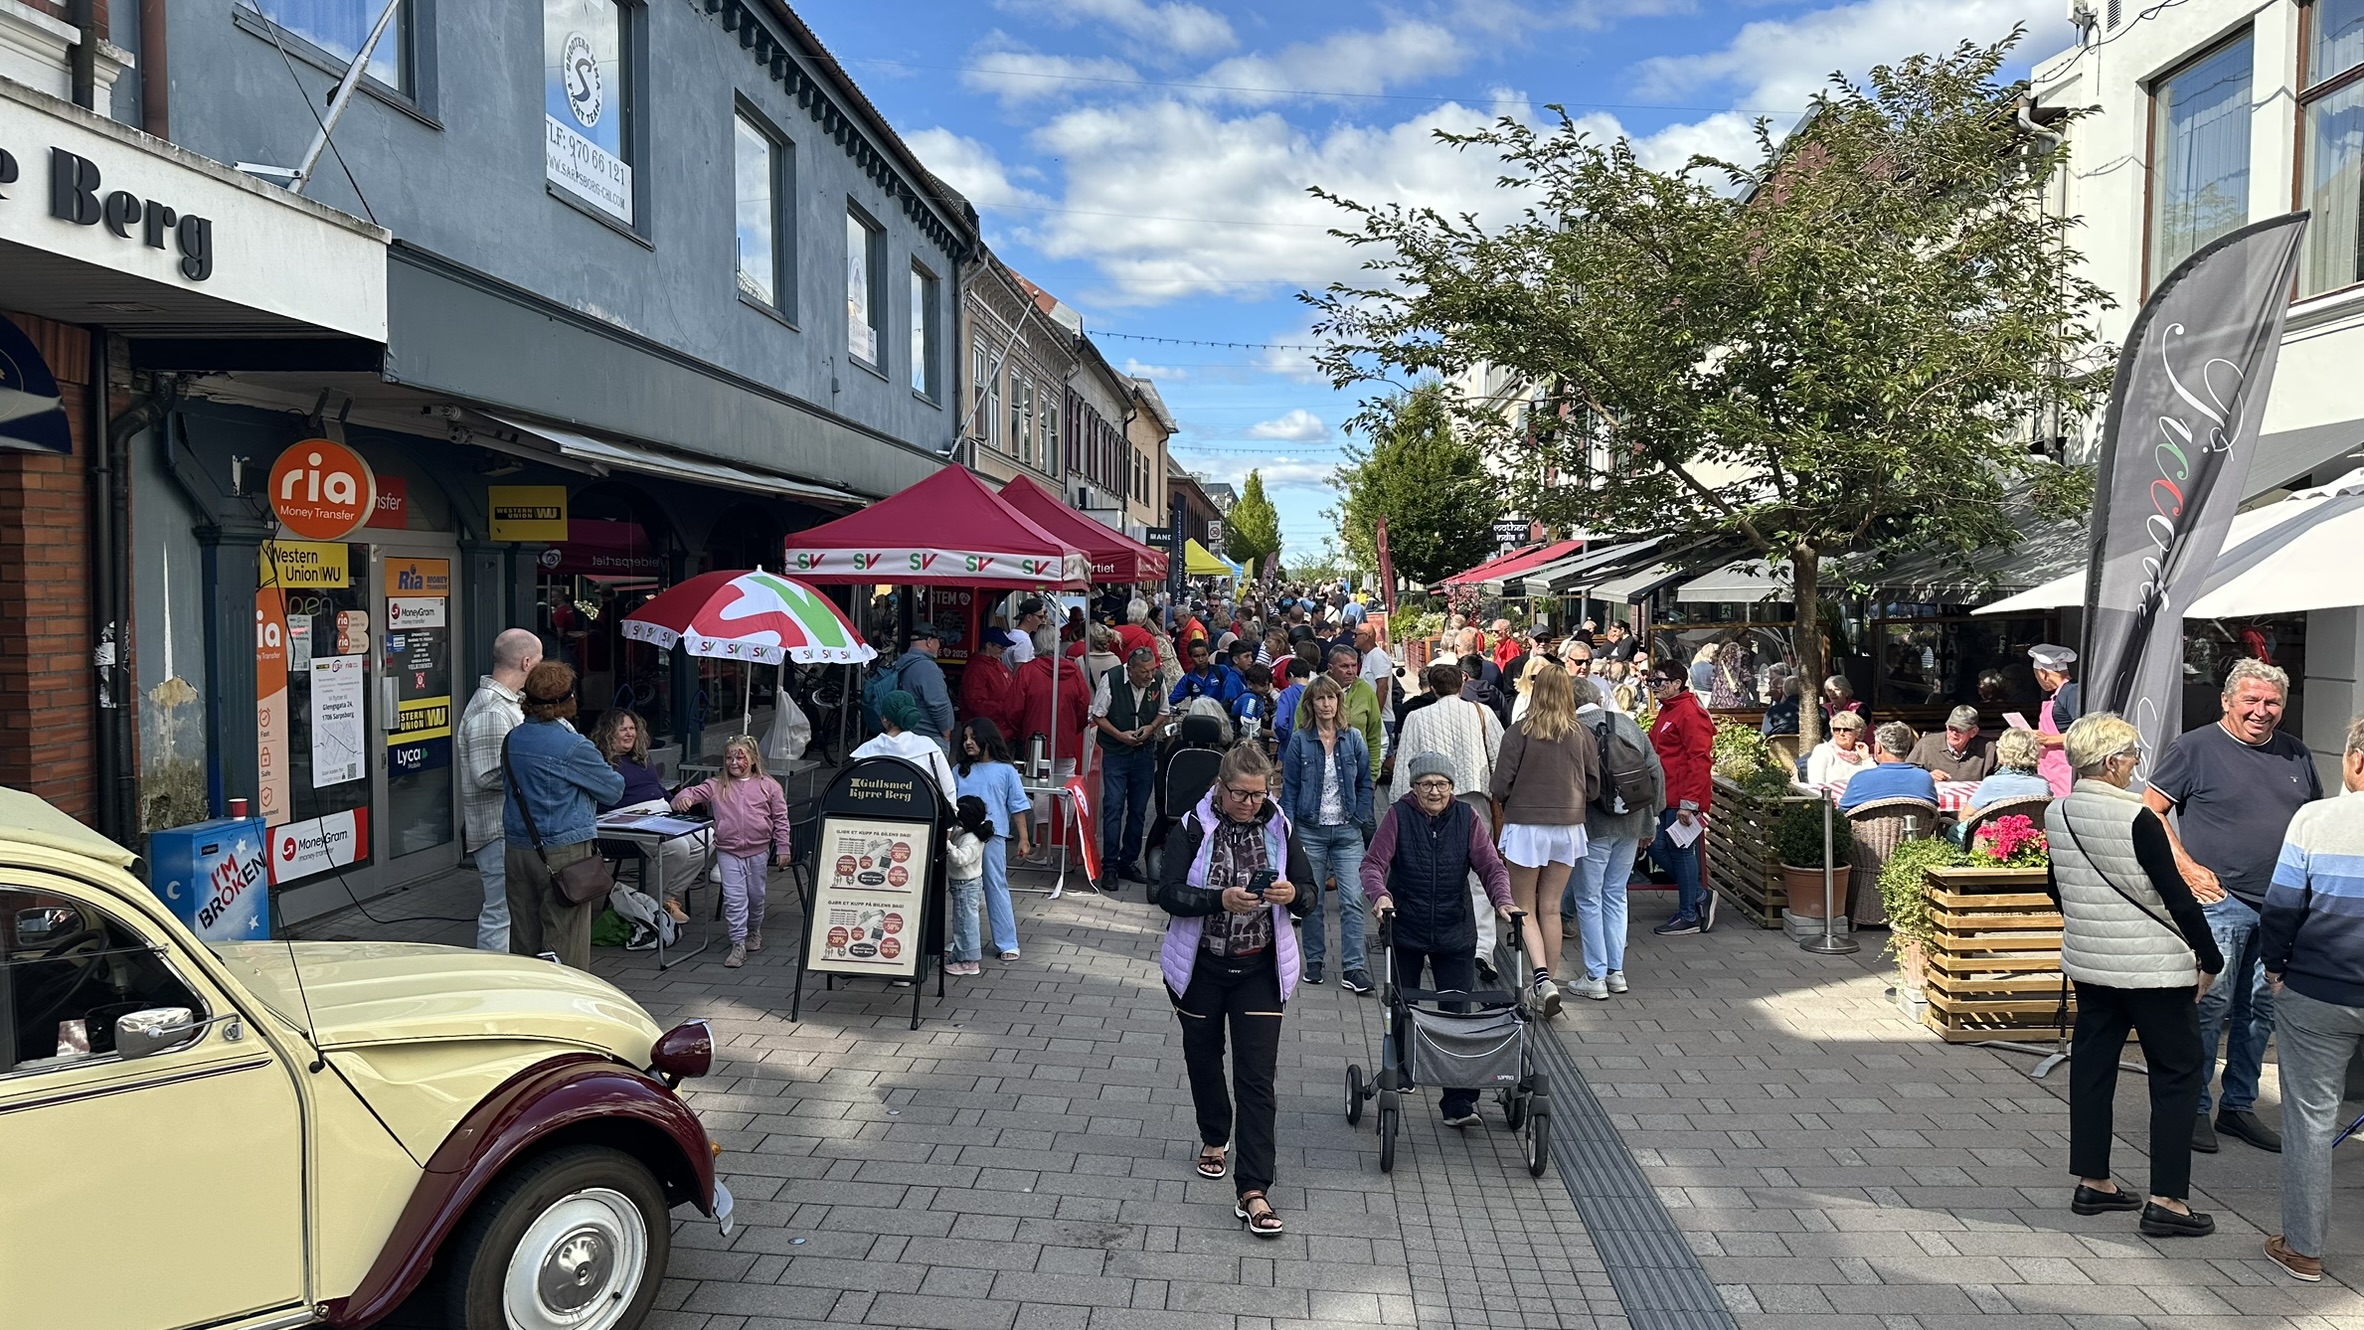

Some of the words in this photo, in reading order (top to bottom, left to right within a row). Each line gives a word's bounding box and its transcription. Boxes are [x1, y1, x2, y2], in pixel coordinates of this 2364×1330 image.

[569, 136, 590, 164] 970
[592, 150, 604, 173] 66
[608, 160, 624, 185] 121
[50, 146, 212, 281] Berg
[282, 452, 356, 505] ria
[376, 493, 402, 510] nsfer
[280, 505, 314, 519] Money
[314, 508, 356, 520] Transfer
[272, 548, 318, 564] Western
[797, 554, 826, 570] SV
[854, 553, 882, 570] SV
[909, 552, 938, 570] SV
[966, 556, 994, 572] SV
[1022, 560, 1050, 576] SV
[286, 566, 318, 582] Union
[1092, 562, 1114, 573] rtiet
[398, 564, 423, 590] Ria
[338, 614, 348, 624] ria
[401, 608, 434, 618] MoneyGram
[256, 610, 280, 648] ia
[338, 636, 348, 646] ria
[701, 641, 716, 652] SV
[727, 644, 742, 654] SV
[753, 647, 767, 658] SV
[804, 649, 813, 659] SV
[823, 649, 832, 658] SV
[841, 650, 850, 660] SV
[952, 650, 968, 658] 2025
[1147, 690, 1160, 702] SV
[400, 710, 424, 722] STERN
[426, 708, 446, 727] WU
[401, 720, 424, 731] UNION
[397, 748, 420, 766] Lyca
[261, 769, 271, 778] Safe
[860, 778, 913, 790] Gullsmed
[849, 788, 882, 799] Kyrre
[885, 790, 911, 802] Berg
[298, 829, 349, 851] MoneyGram
[298, 851, 315, 861] money
[210, 853, 239, 892] I'M
[198, 850, 267, 930] BROKEN
